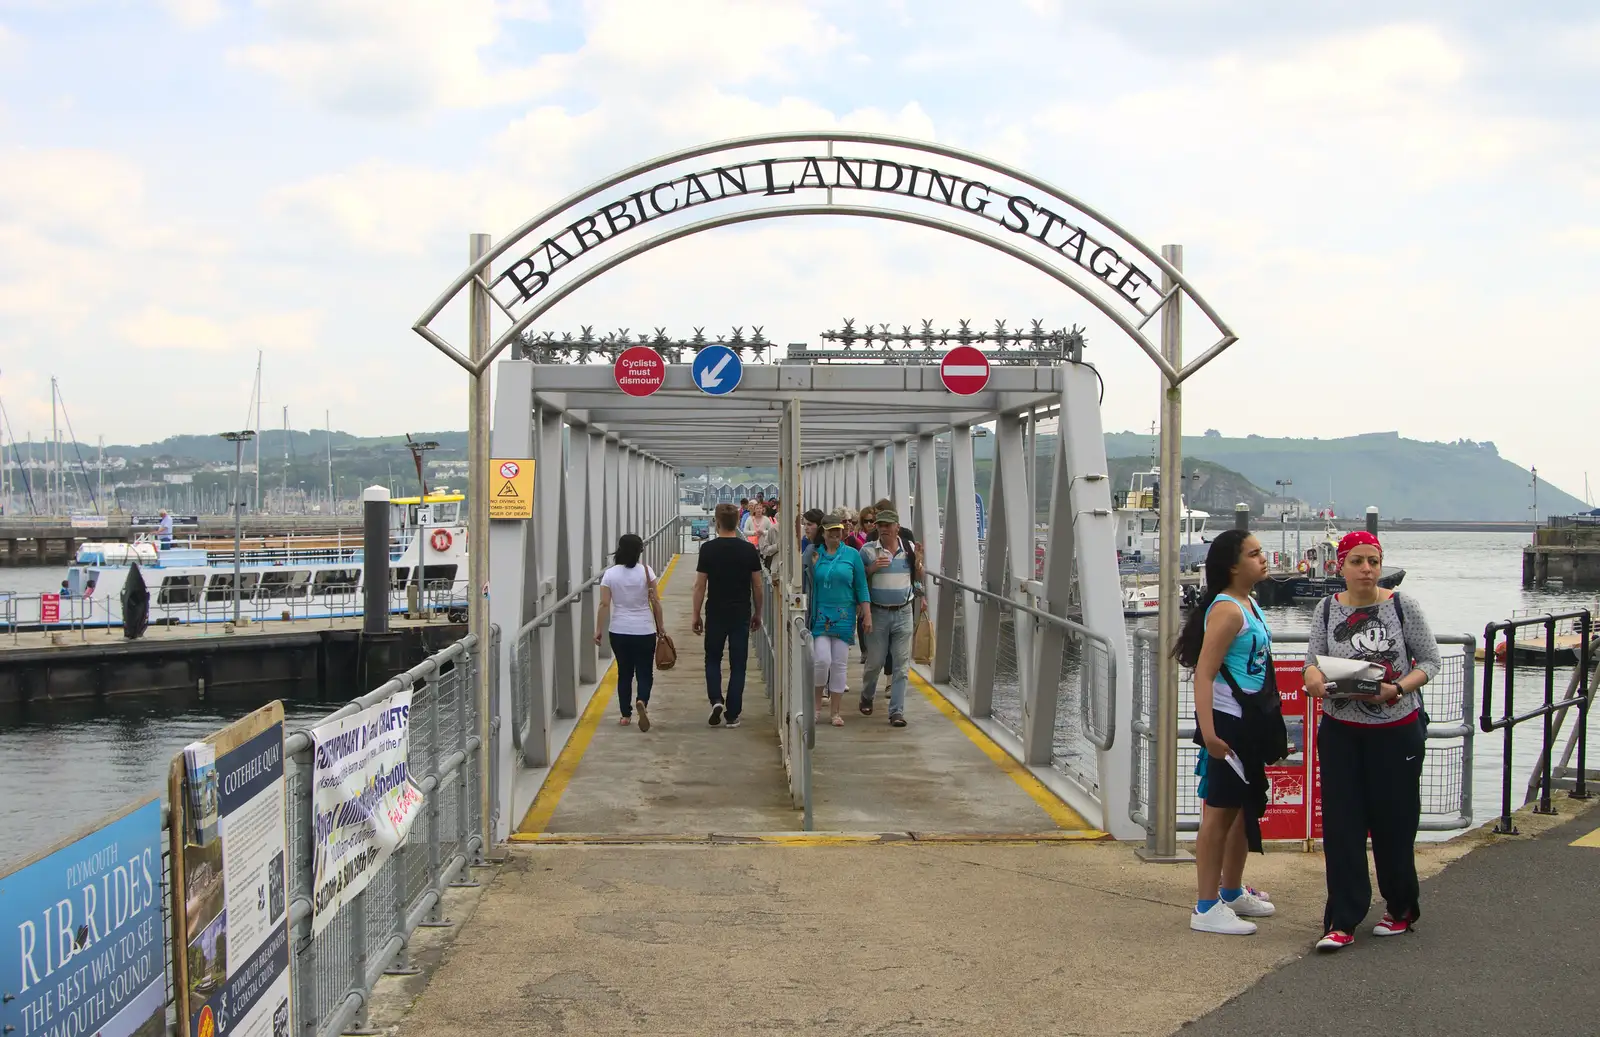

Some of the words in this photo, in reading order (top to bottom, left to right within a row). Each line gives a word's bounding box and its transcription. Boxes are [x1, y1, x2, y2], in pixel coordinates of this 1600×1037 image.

[501, 164, 748, 304] BARBICAN
[759, 156, 992, 214] LANDING
[1000, 195, 1152, 304] STAGE
[622, 359, 657, 368] Cyclists
[421, 514, 427, 523] 4
[379, 705, 409, 736] CRAFTS
[385, 738, 397, 751] the
[224, 754, 262, 795] COTEHELE
[262, 742, 280, 772] QUAY
[66, 842, 118, 890] PLYMOUTH
[18, 898, 76, 994] RIB
[82, 846, 153, 951] RIDES
[21, 989, 53, 1037] THE
[58, 964, 88, 1012] BEST
[91, 943, 117, 987] WAY
[119, 931, 135, 964] TO
[138, 916, 153, 951] SEE
[110, 951, 152, 1009] SOUND!
[231, 957, 259, 998] PLYMOUTH
[258, 929, 286, 968] BREAKWATER
[232, 1003, 238, 1017] &
[237, 978, 259, 1011] COASTAL
[258, 960, 274, 988] CRUISE
